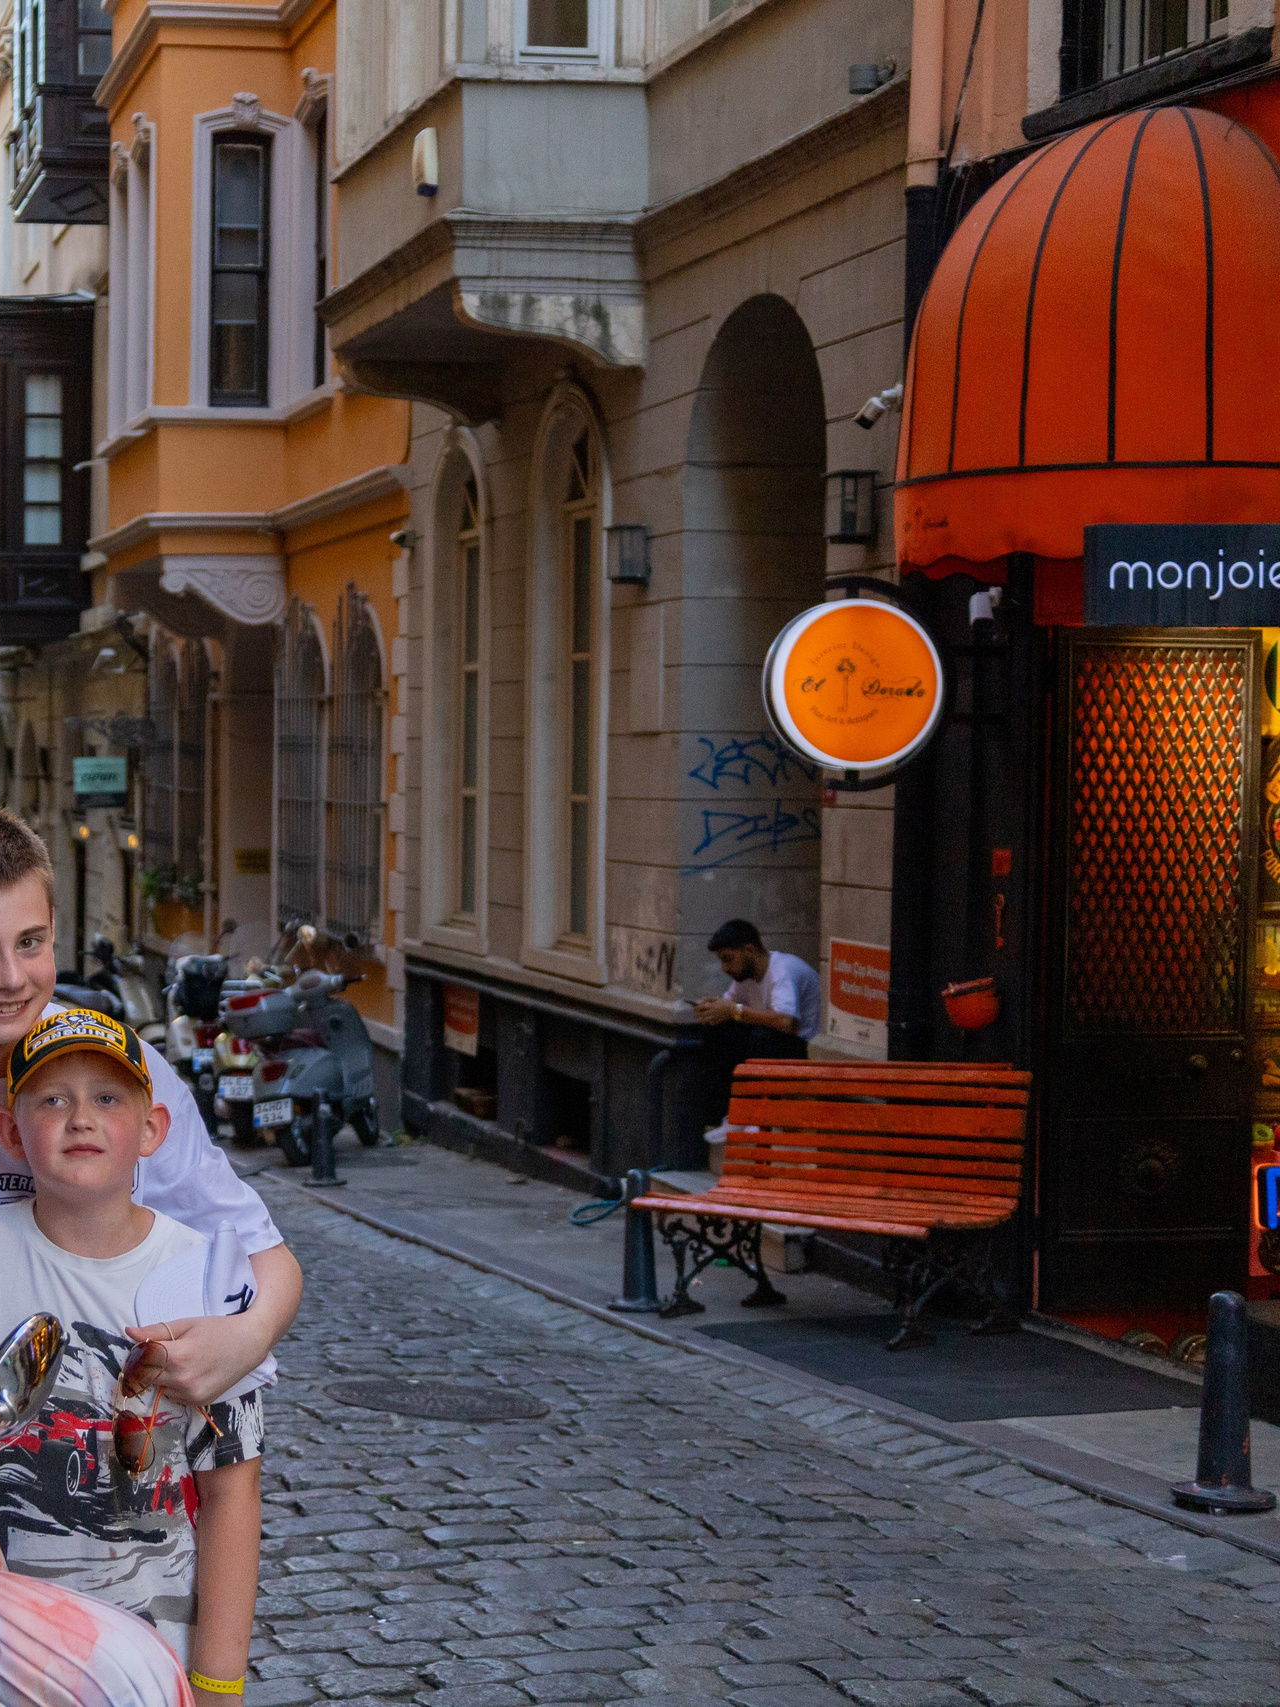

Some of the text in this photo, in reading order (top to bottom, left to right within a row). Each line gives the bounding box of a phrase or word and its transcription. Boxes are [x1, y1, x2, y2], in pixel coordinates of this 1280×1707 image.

[801, 675, 926, 699] El Dorado
[31, 1027, 116, 1050] PENGUINS
